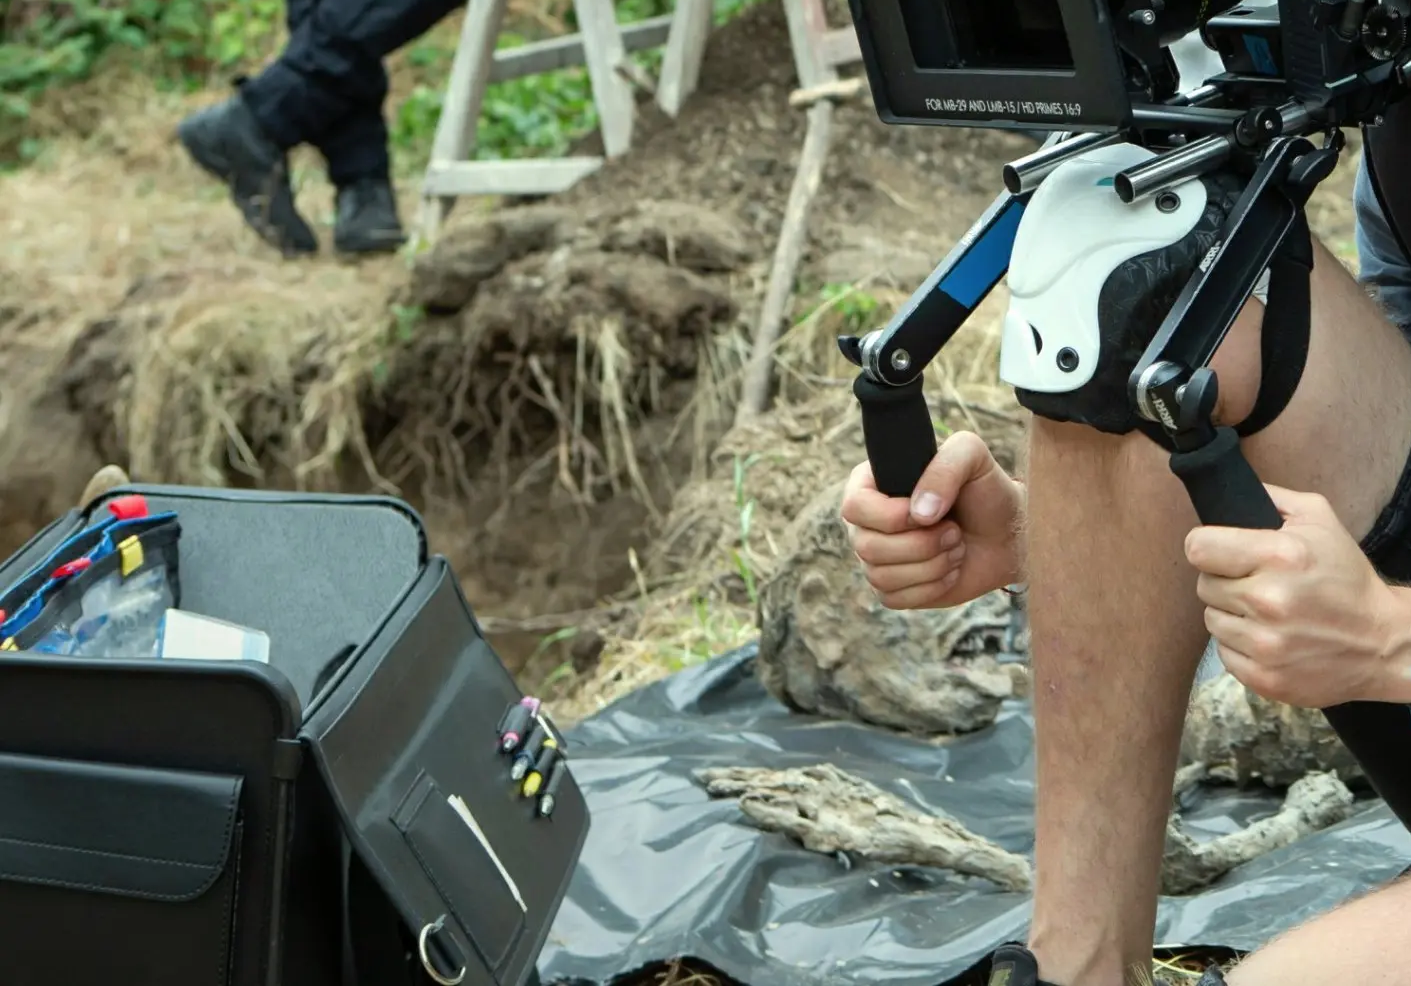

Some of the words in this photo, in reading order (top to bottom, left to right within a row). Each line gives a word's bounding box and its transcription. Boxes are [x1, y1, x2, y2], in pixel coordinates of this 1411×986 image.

[925, 98, 944, 111] FOR
[943, 99, 967, 112] MB-29
[969, 100, 986, 113] AND
[987, 100, 1016, 114] LMB-15
[1022, 101, 1035, 114] HD
[1035, 102, 1064, 115] PRIMES
[1063, 103, 1082, 116] 16:9
